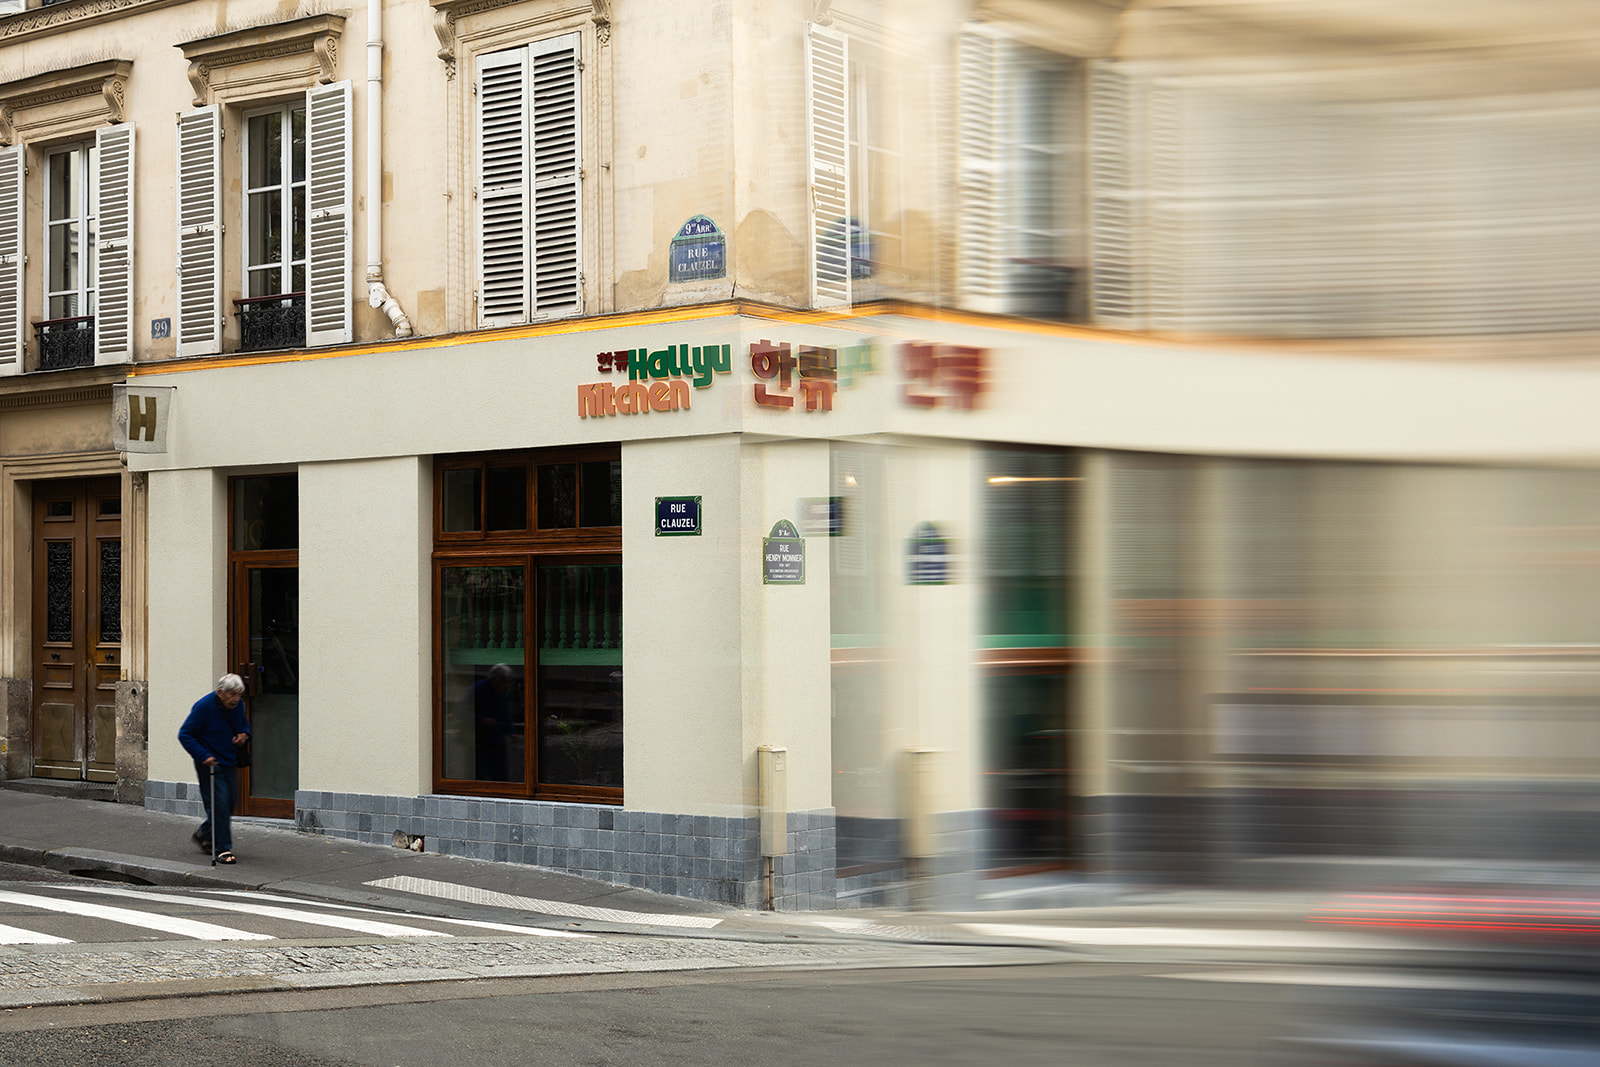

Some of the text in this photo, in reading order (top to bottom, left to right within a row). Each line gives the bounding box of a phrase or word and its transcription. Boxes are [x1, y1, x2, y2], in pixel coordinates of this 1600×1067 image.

[688, 247, 708, 259] RUE
[678, 260, 718, 272] CLAUZEL
[154, 321, 168, 337] 29
[597, 344, 732, 388] 한류 Hallyu
[578, 379, 691, 418] Kitchen
[128, 395, 157, 441] H
[670, 503, 687, 513] RUE
[661, 518, 696, 528] CLAUZEL
[779, 544, 790, 553] RUE
[766, 554, 781, 562] HENRY
